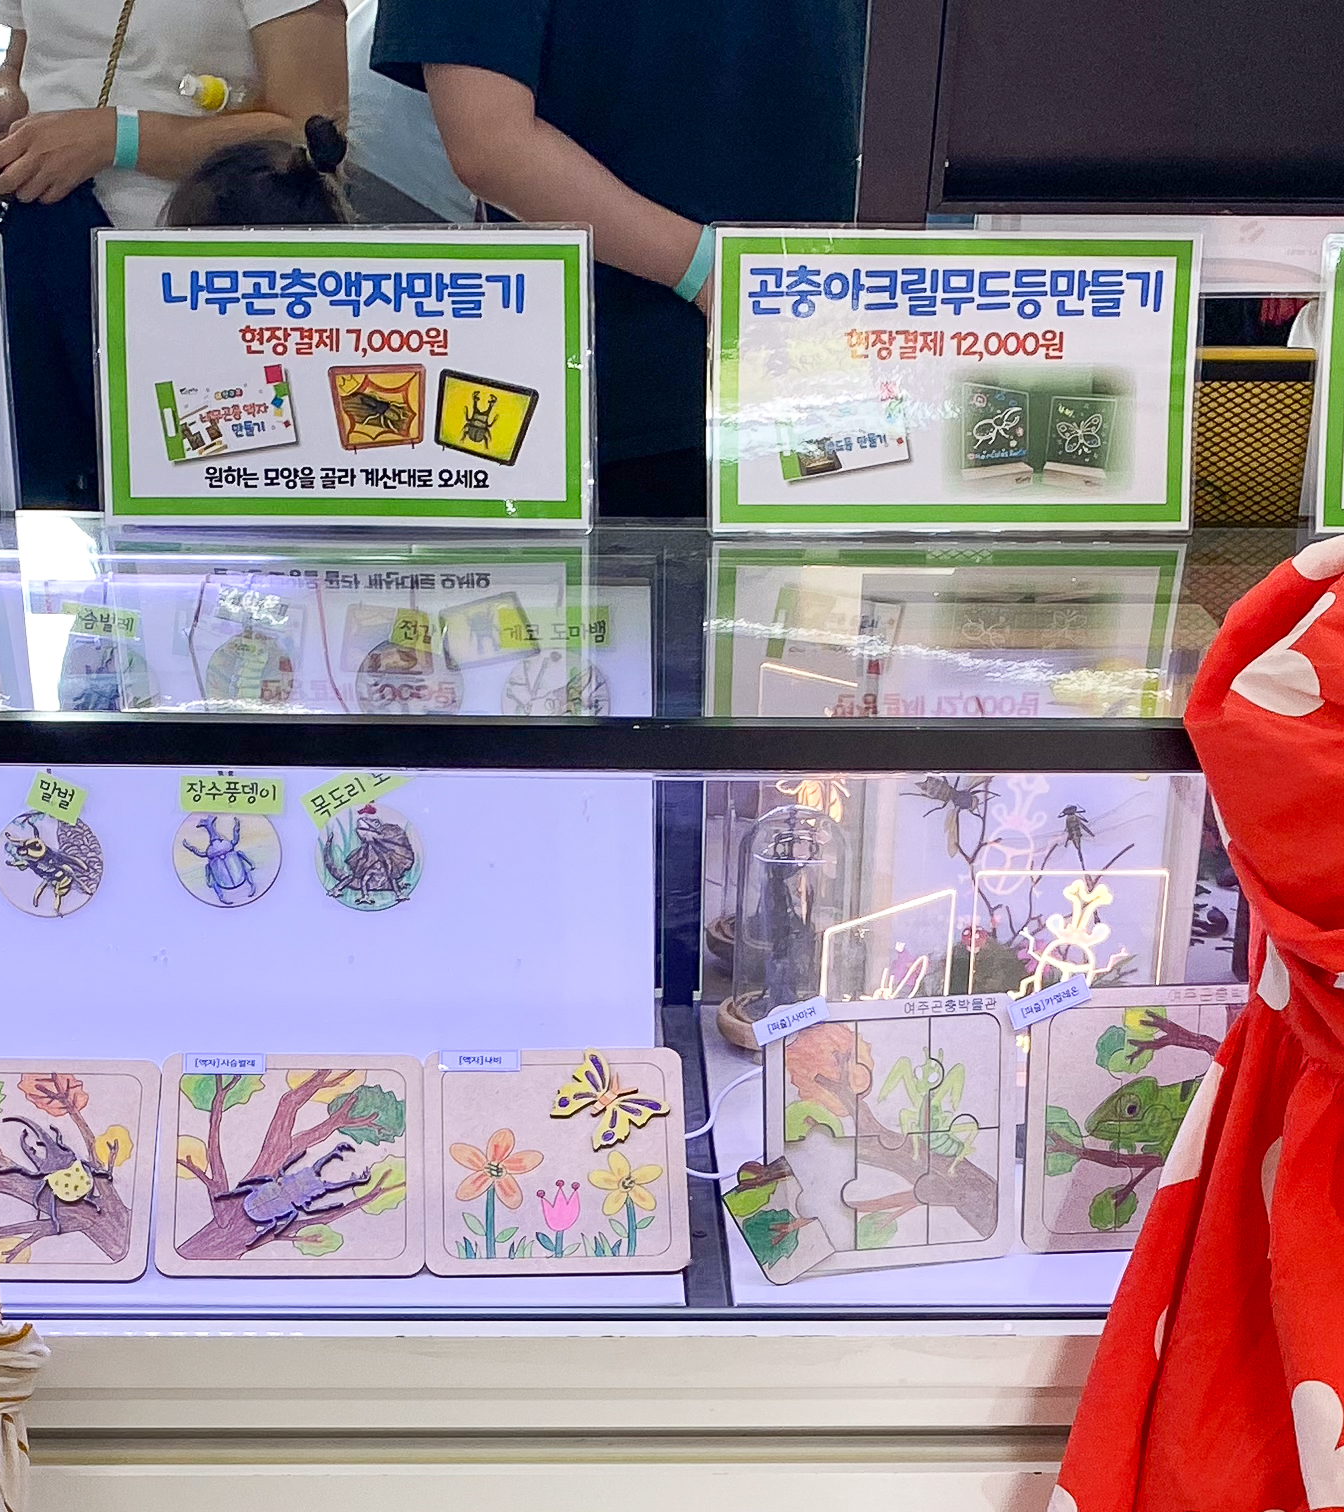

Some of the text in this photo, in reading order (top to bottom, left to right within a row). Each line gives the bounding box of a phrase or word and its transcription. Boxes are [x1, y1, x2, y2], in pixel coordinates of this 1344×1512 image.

[161, 267, 526, 320] 나무곤충액자만들기
[747, 264, 1165, 320] 곤충아크릴무드등만들기
[238, 324, 449, 358] 현장결제 7,000원
[844, 328, 1065, 362] 현장결제 12,000원
[243, 402, 269, 418] 액자
[231, 420, 266, 438] 만들기
[204, 465, 491, 490] 원하는 모양을 골라 계산대로 오세요
[77, 607, 135, 633] 슴벌레
[552, 620, 607, 644] 도마뱀
[39, 779, 76, 811] 말벌
[186, 779, 277, 805] 장수풍뎅이
[309, 776, 367, 818] 목도리
[904, 996, 998, 1015] 여주곤충박물관
[458, 1054, 503, 1067] [액자]나비
